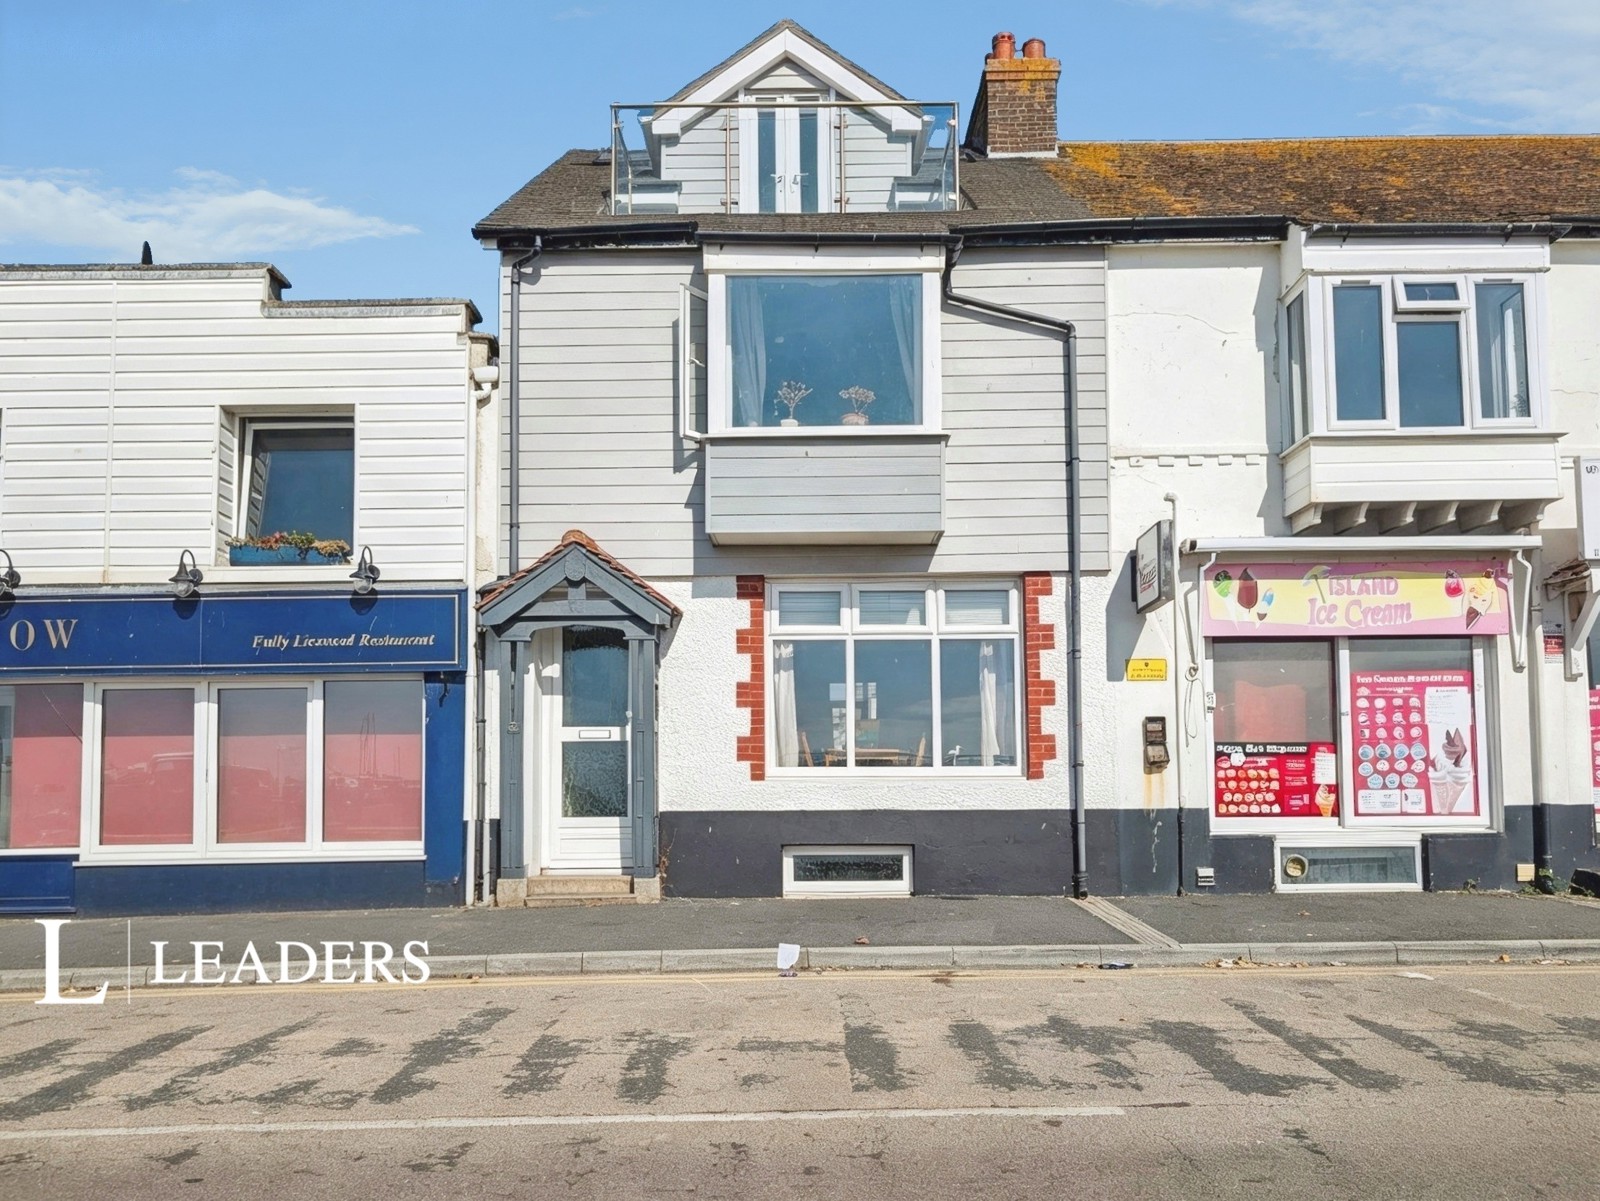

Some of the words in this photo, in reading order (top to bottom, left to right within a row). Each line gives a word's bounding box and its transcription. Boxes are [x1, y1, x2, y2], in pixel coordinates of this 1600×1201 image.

[1328, 576, 1399, 596] ISLAND
[1307, 597, 1338, 625] Ice
[1344, 599, 1413, 628] Cream
[252, 634, 290, 651] Fully
